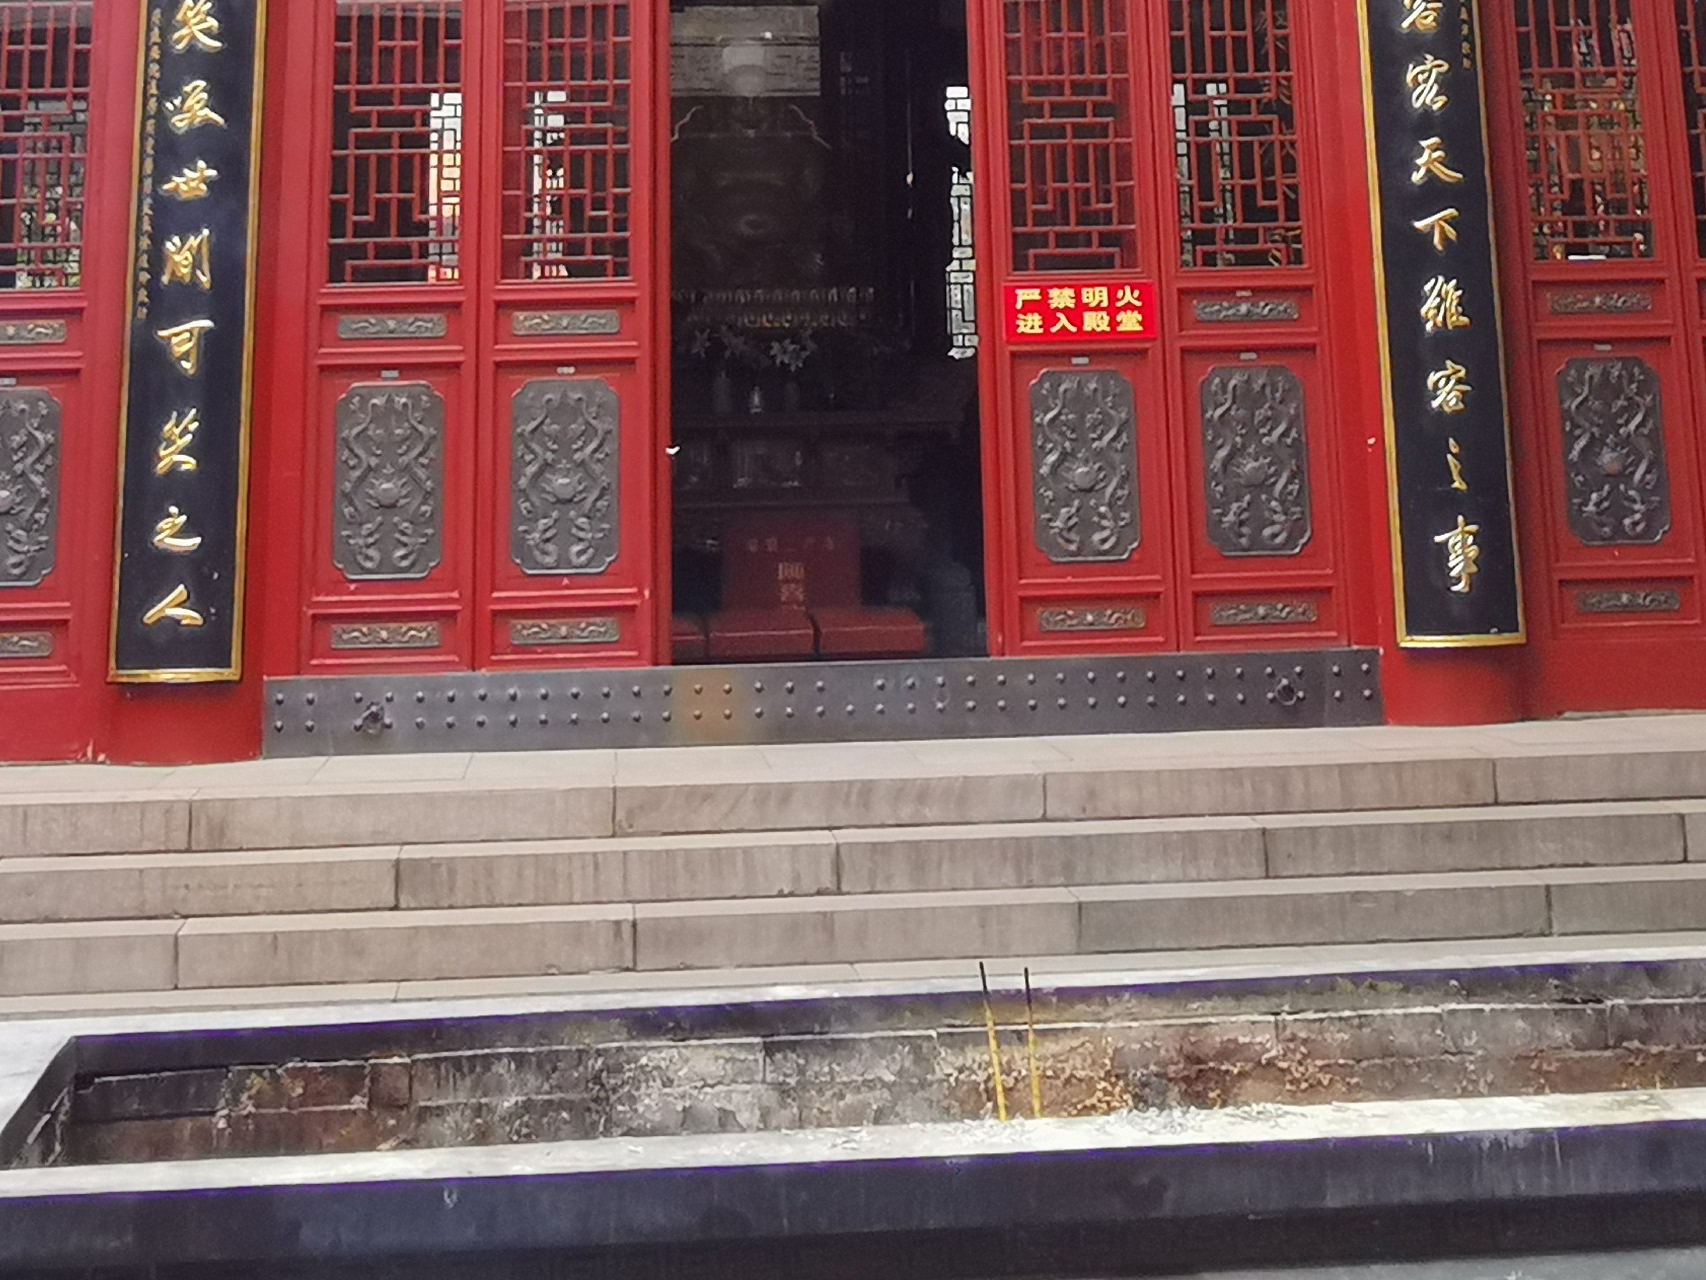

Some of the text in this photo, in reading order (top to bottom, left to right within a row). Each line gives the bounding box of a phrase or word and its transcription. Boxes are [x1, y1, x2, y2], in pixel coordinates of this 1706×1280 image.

[1014, 285, 1142, 310] 严禁明火
[1015, 309, 1144, 334] 进入殿堂
